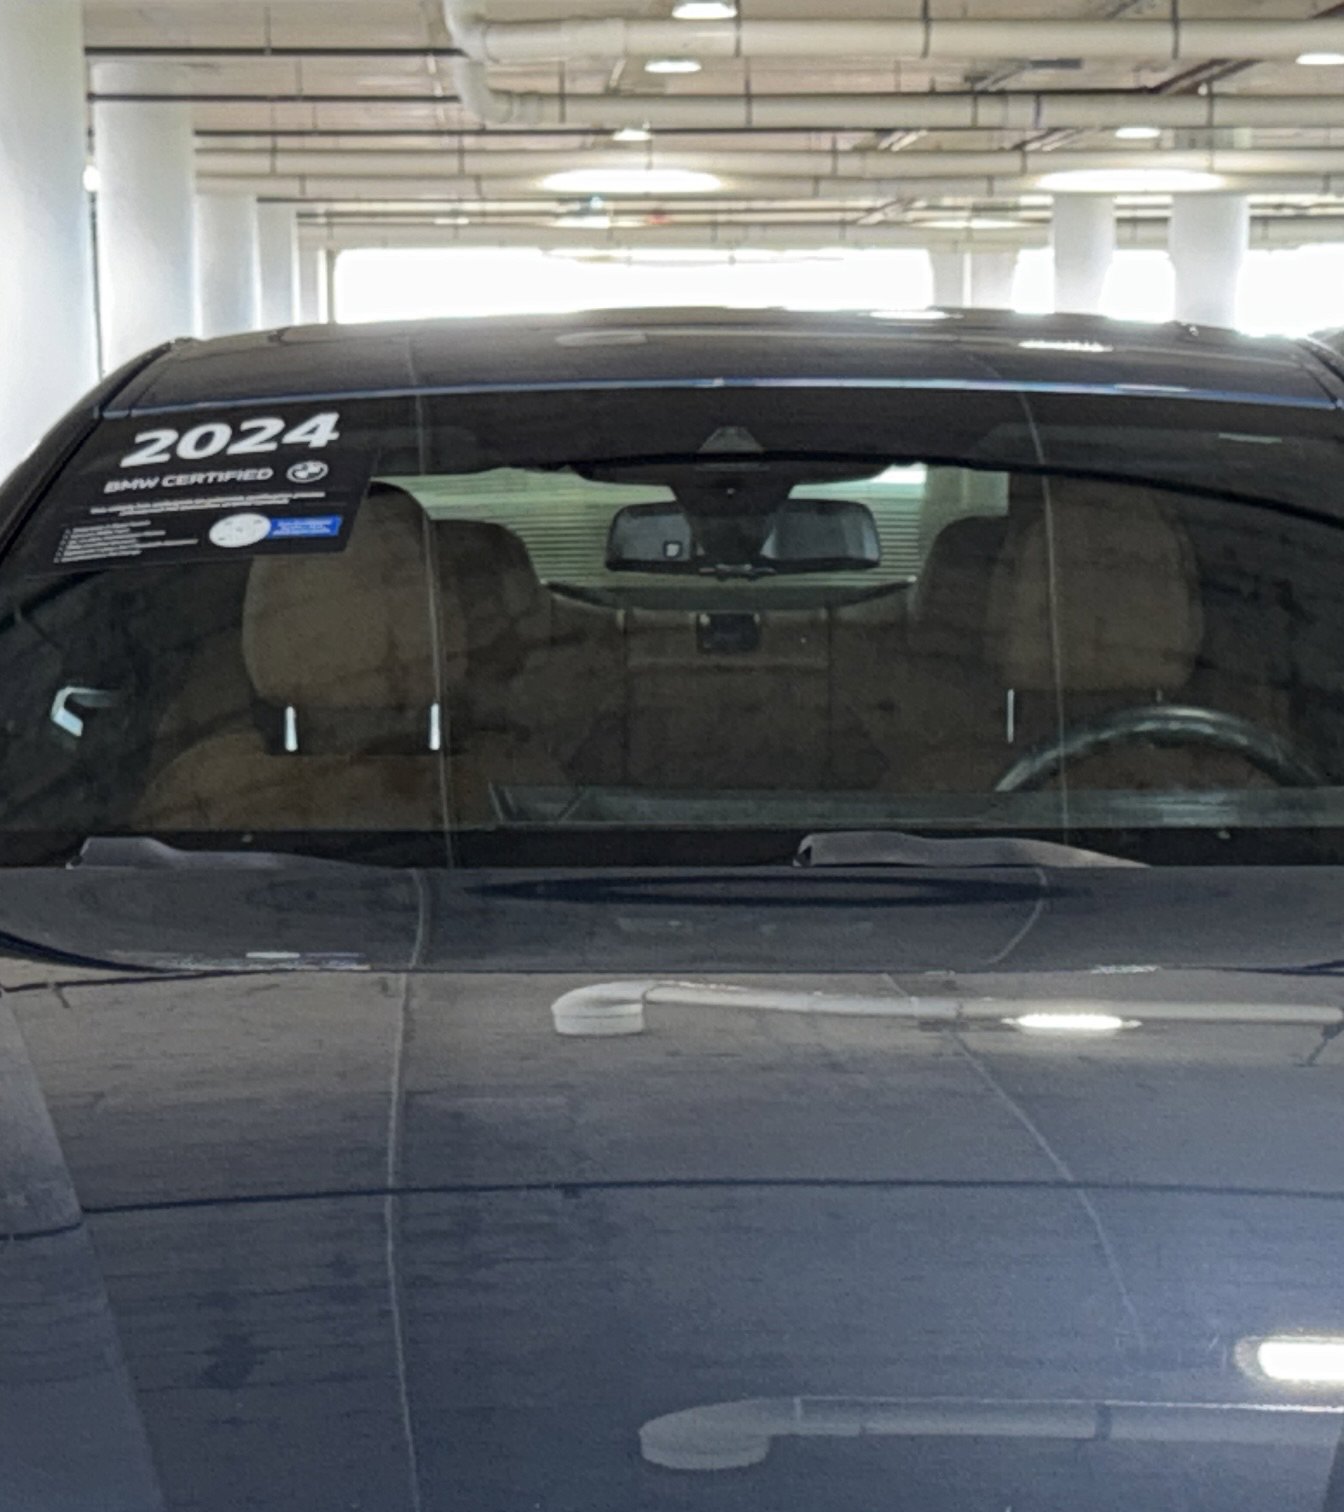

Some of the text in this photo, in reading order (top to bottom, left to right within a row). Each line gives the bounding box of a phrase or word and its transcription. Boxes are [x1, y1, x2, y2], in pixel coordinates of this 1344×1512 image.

[120, 412, 340, 468] 2024
[104, 467, 274, 494] BMW CERTIFIED
